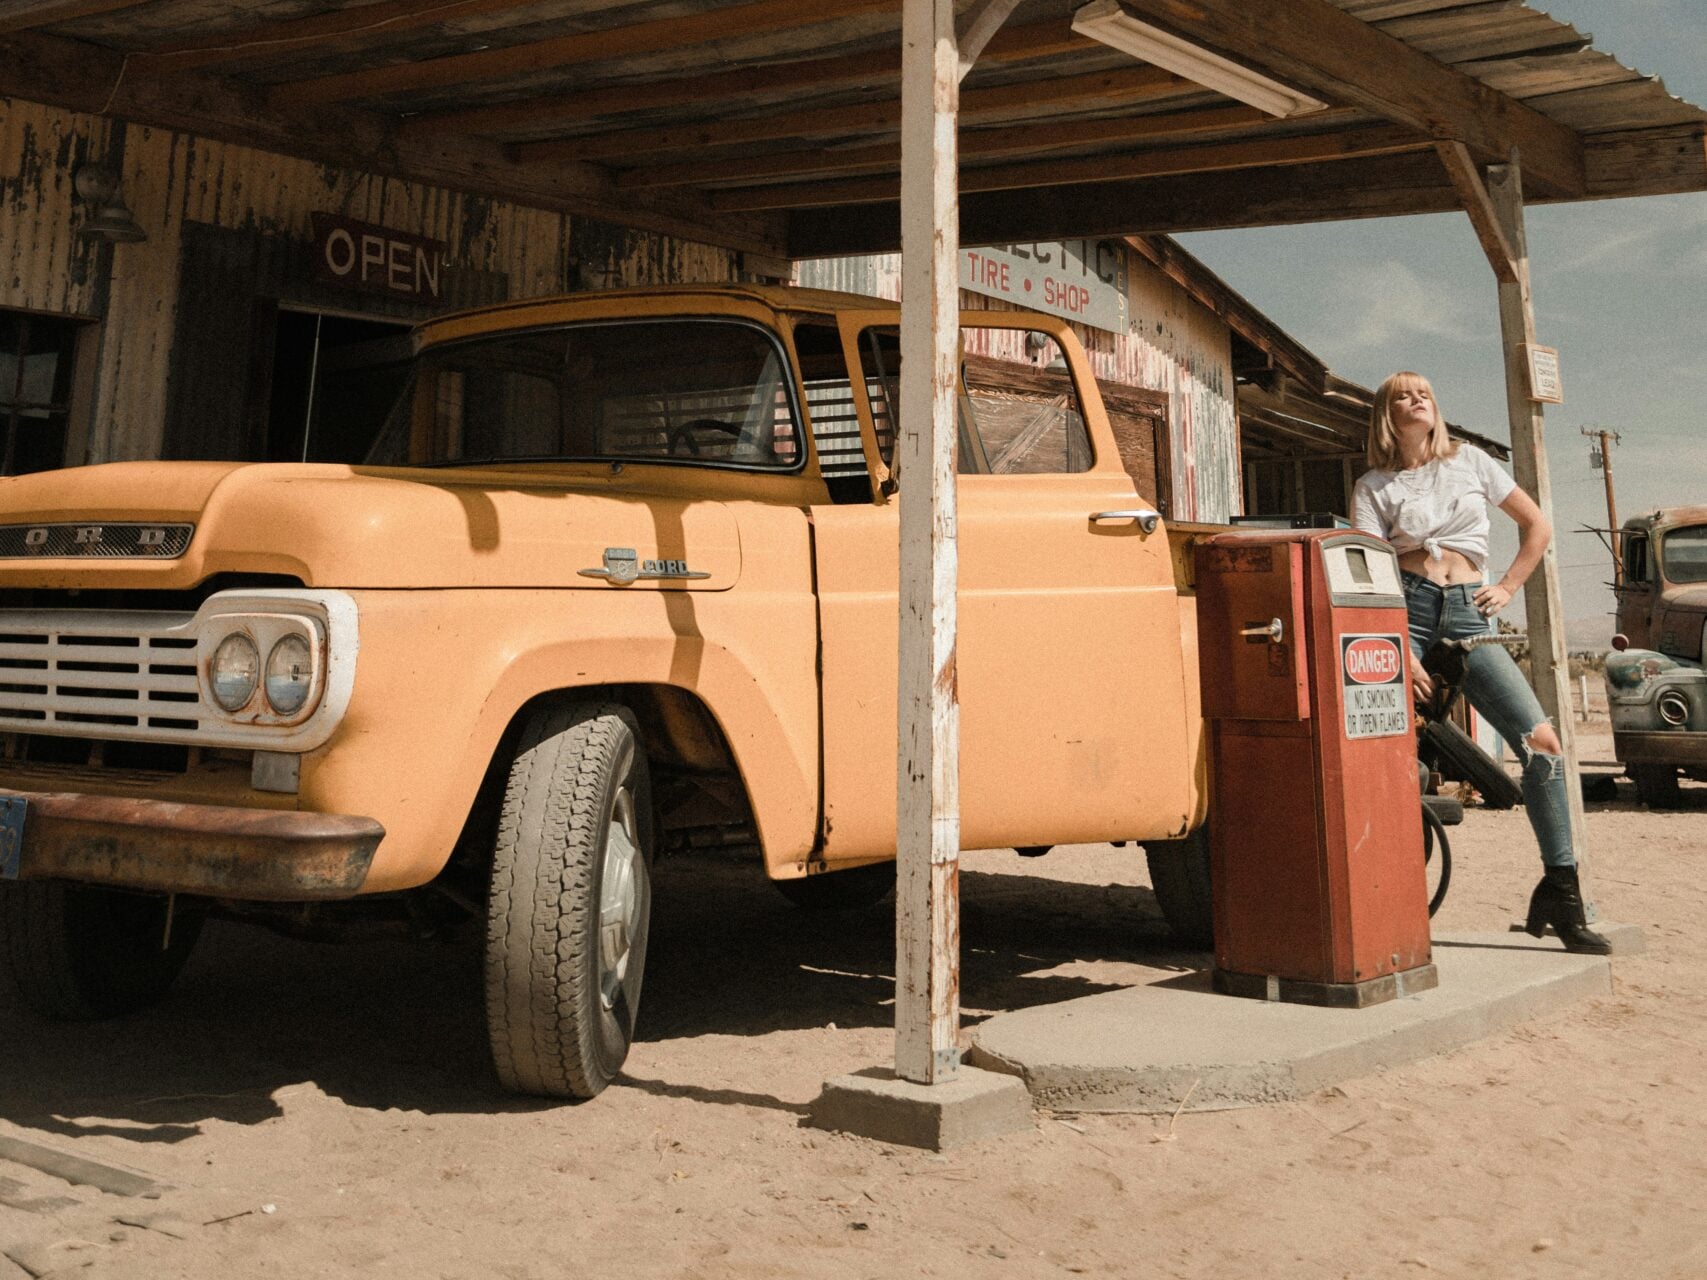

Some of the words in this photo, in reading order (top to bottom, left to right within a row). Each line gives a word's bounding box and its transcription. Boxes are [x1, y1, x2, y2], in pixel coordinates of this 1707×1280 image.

[325, 228, 438, 297] OPEN
[967, 252, 1010, 292] TIRE
[1044, 277, 1090, 314] SHOP
[25, 526, 166, 545] ORD
[1349, 649, 1397, 673] DANGER
[1354, 689, 1364, 709] NO
[1367, 688, 1396, 708] SMOKING
[1347, 714, 1357, 734] OR
[1360, 713, 1377, 733] OPEN
[1379, 712, 1405, 732] FLAMES
